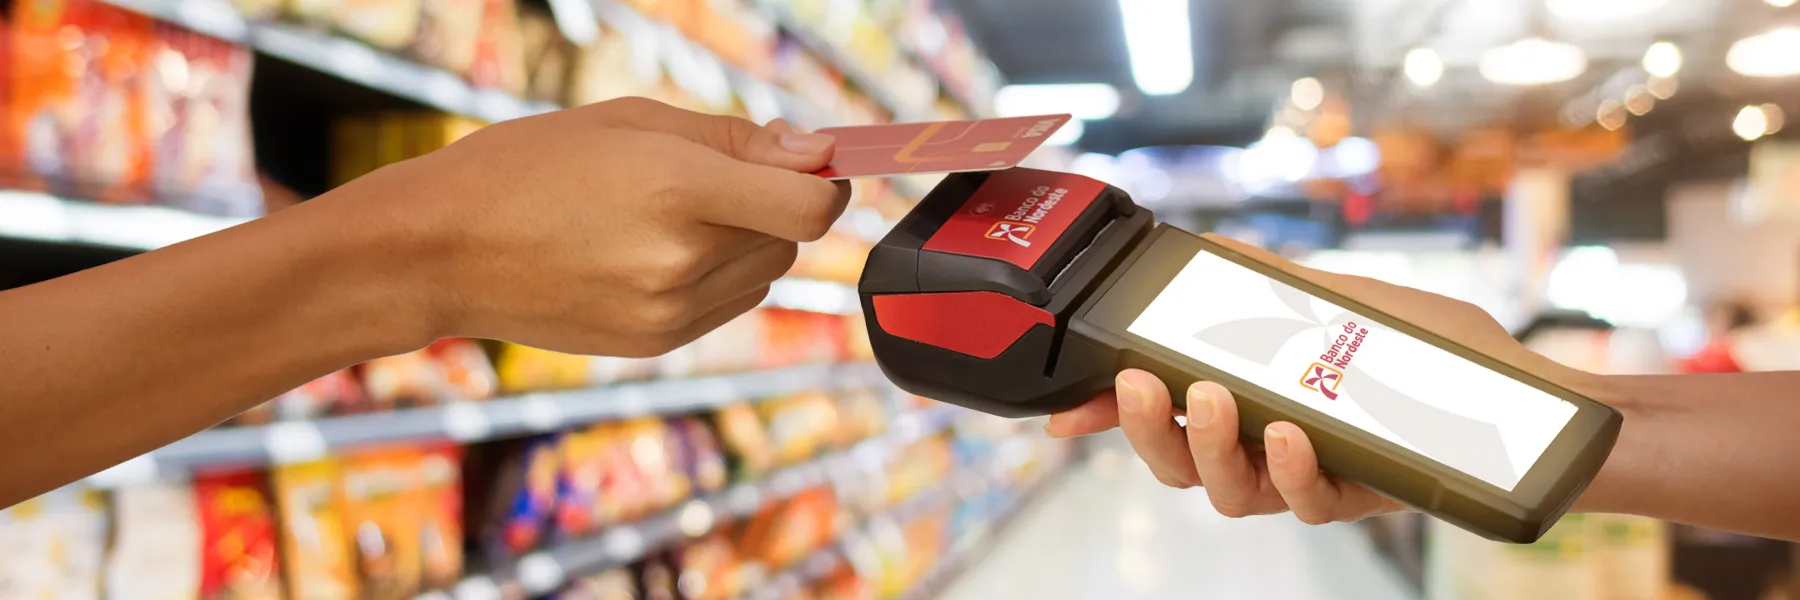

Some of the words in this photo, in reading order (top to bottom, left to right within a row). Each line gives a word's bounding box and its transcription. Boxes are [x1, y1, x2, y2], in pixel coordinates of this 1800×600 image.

[1020, 118, 1060, 138] VISA
[1004, 197, 1039, 220] Banco
[1031, 185, 1050, 196] do
[1022, 188, 1068, 224] Nordeste
[1319, 334, 1348, 363] Banco
[1342, 321, 1357, 334] do
[1333, 327, 1368, 369] Nordeste
